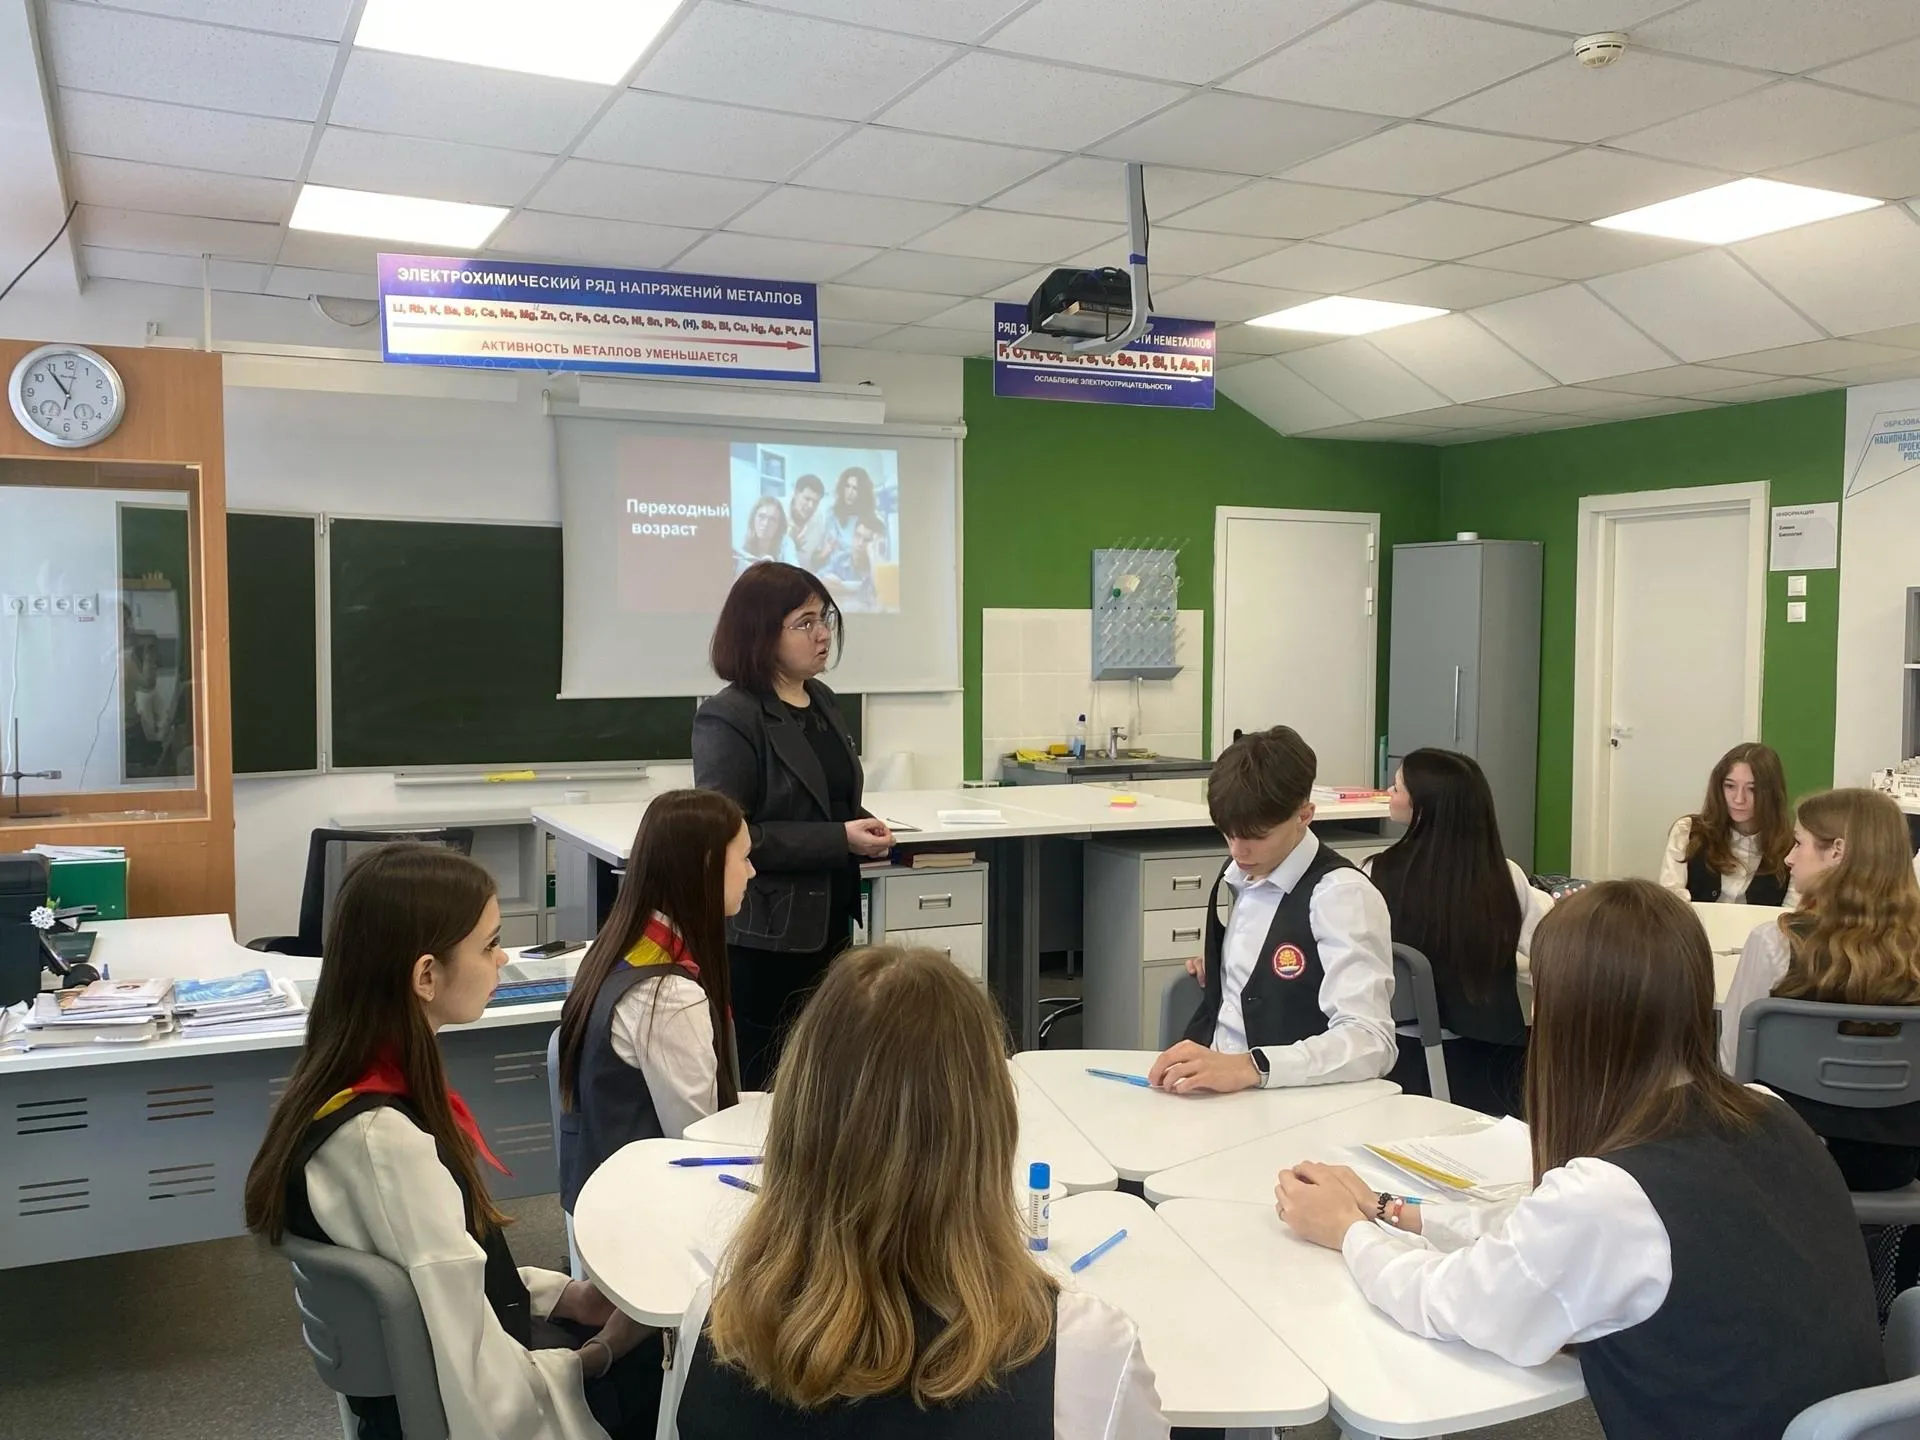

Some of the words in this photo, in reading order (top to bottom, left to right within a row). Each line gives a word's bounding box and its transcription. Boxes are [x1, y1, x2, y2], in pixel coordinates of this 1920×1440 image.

[397, 267, 580, 290] ЭЛЕКТРОХИМИЧЕСКИЙ
[585, 278, 616, 294] РЯД
[620, 281, 722, 301] НАПРЯЖЕНИЙ
[726, 289, 803, 306] МЕТАЛЛОВ
[429, 305, 442, 316] K,
[519, 309, 539, 322] Mg,
[540, 310, 557, 322] Zn,
[559, 311, 574, 324] Cr,
[593, 313, 610, 326] Cd,
[612, 314, 630, 327] Co,
[665, 317, 681, 329] Pb,
[682, 318, 700, 331] (H),
[733, 322, 750, 333] Cu,
[751, 323, 767, 335] Hg,
[768, 324, 784, 336] Ag,
[785, 325, 798, 336] Pt,
[799, 326, 813, 337] Au
[997, 322, 1017, 335] РЯД
[1153, 335, 1212, 349] НЕМЕТАЛЛОВ
[481, 340, 569, 355] АКТИВНОСТЬ
[573, 345, 642, 358] МЕТАЛЛОВ
[646, 349, 739, 363] УМЕНЬШАЕТСЯ
[47, 363, 56, 373] 11
[64, 360, 75, 370] 12
[1139, 354, 1150, 369] P,
[1201, 359, 1211, 372] H
[85, 368, 89, 376] 1
[34, 373, 45, 383] 10
[1034, 375, 1079, 385] ОСЛАБЛЕНИЕ
[1080, 378, 1173, 391] ЭЛЕКТРООТРИЦАТЕЛЬНОСТИ
[96, 379, 103, 389] 2
[27, 388, 34, 397] 9
[101, 396, 108, 405] 3
[31, 405, 38, 414] 8
[95, 412, 102, 420] 4
[46, 417, 53, 426] 7
[81, 421, 88, 431] 5
[63, 422, 70, 432] 6
[626, 498, 730, 518] Переходный
[631, 522, 698, 539] возраст
